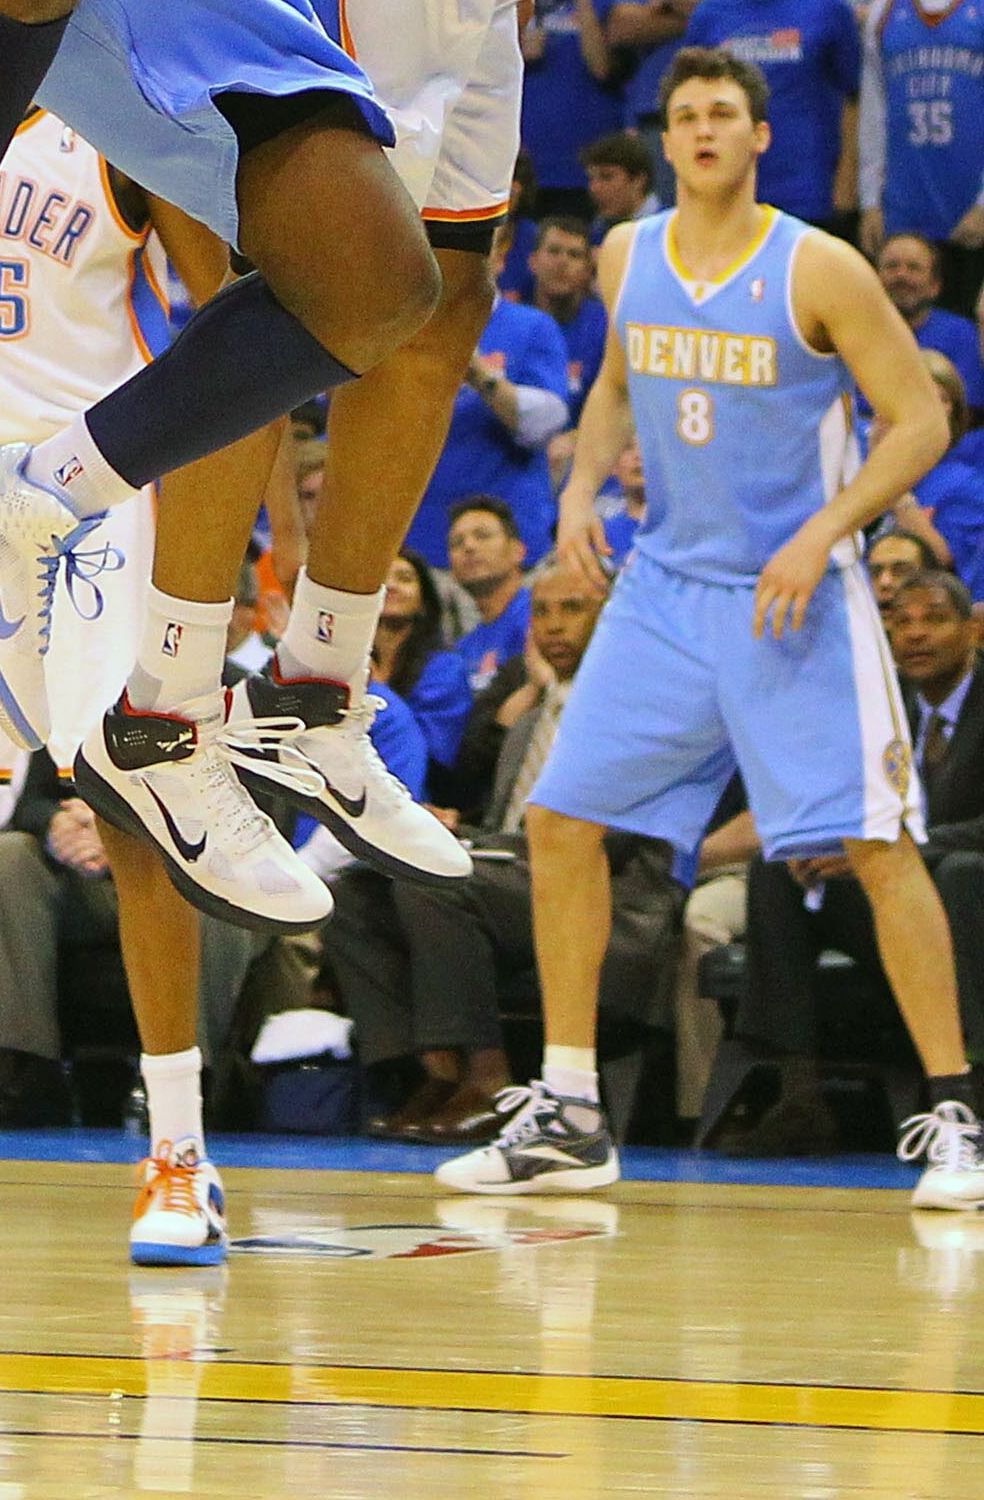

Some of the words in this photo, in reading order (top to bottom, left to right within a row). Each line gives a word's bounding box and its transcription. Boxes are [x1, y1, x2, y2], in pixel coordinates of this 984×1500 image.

[907, 100, 954, 145] 35
[625, 322, 778, 386] DENVER
[676, 387, 714, 446] 8
